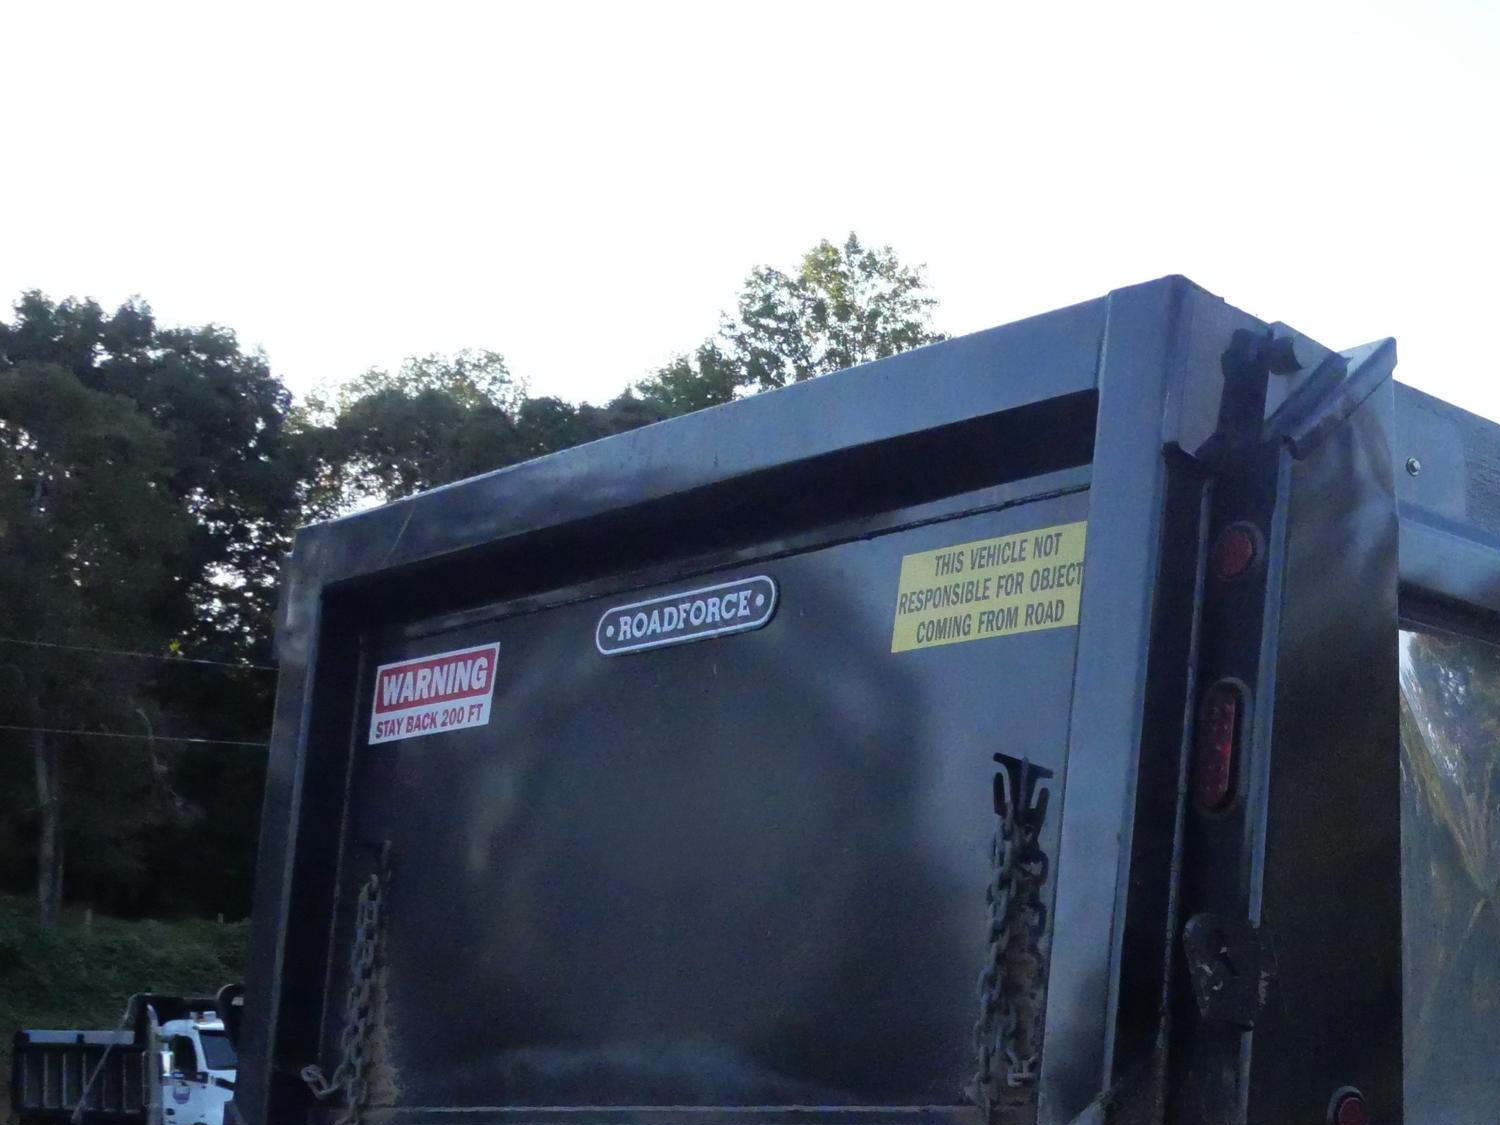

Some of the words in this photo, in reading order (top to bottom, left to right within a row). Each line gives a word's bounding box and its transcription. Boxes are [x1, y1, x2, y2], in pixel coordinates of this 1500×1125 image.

[935, 551, 964, 577] THIS
[970, 539, 1028, 570] VEHICLE
[1032, 532, 1062, 559] NOT
[898, 577, 992, 615] RESPONSIBLE
[995, 572, 1024, 598] FOR
[1030, 561, 1084, 592] OBJECT
[617, 590, 752, 641] ROADFORCE
[916, 613, 972, 644] COMING
[977, 606, 1019, 634] FROM
[1025, 599, 1065, 626] ROAD
[383, 656, 488, 706] WARNING
[375, 717, 405, 739] STAY
[406, 710, 438, 733] BACK
[440, 706, 465, 727] 200
[468, 703, 483, 722] FT
